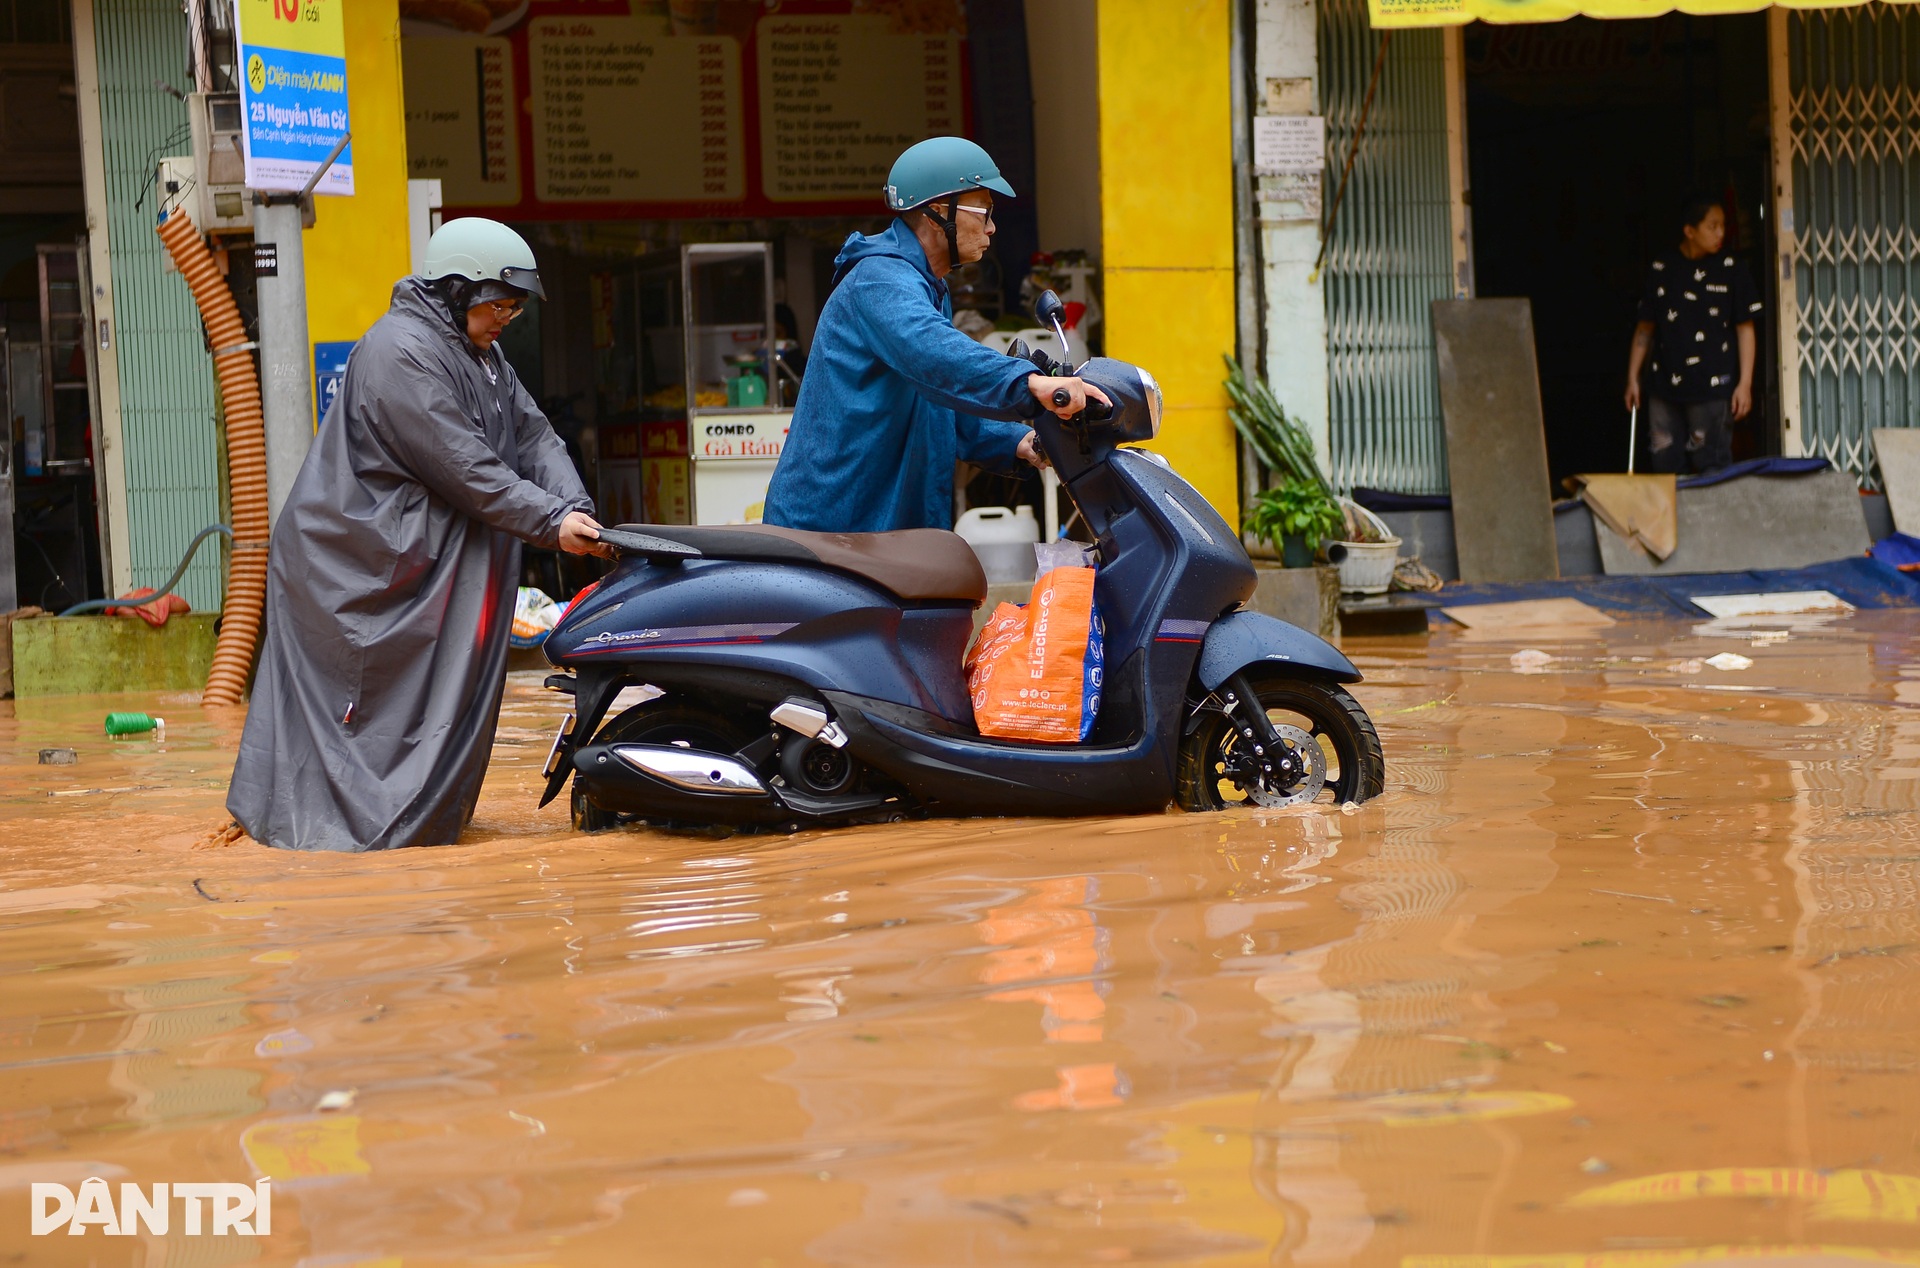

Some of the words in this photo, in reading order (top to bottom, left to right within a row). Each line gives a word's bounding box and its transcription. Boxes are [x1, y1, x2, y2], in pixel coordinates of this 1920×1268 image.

[541, 25, 565, 36] TRÀ
[542, 43, 560, 56] Trà
[698, 43, 722, 55] 25K
[543, 59, 560, 71] Trà
[606, 59, 645, 73] topping
[543, 75, 561, 87] Trà
[700, 75, 723, 86] 25K
[544, 91, 562, 102] Trà
[700, 90, 725, 101] 20K
[251, 102, 265, 122] 25
[267, 103, 308, 129] Nguyễn
[309, 107, 330, 129] Văn
[545, 106, 563, 118] Trà
[701, 105, 726, 116] 20K
[545, 121, 564, 133] Trà
[702, 121, 727, 131] 20K
[265, 128, 281, 143] Cạnh
[281, 130, 296, 145] Ngân
[297, 131, 311, 147] Hàng
[546, 137, 565, 149] Trà
[703, 136, 727, 147] 20K
[547, 153, 565, 165] Trà
[703, 151, 728, 162] 20K
[548, 168, 566, 180] Trà
[703, 167, 727, 178] 25K
[326, 378, 344, 397] 4
[706, 425, 755, 436] COMBO
[705, 438, 732, 456] Gà
[741, 437, 780, 455] Rán
[590, 629, 661, 644] Grande
[1031, 608, 1049, 680] E.Leclerc
